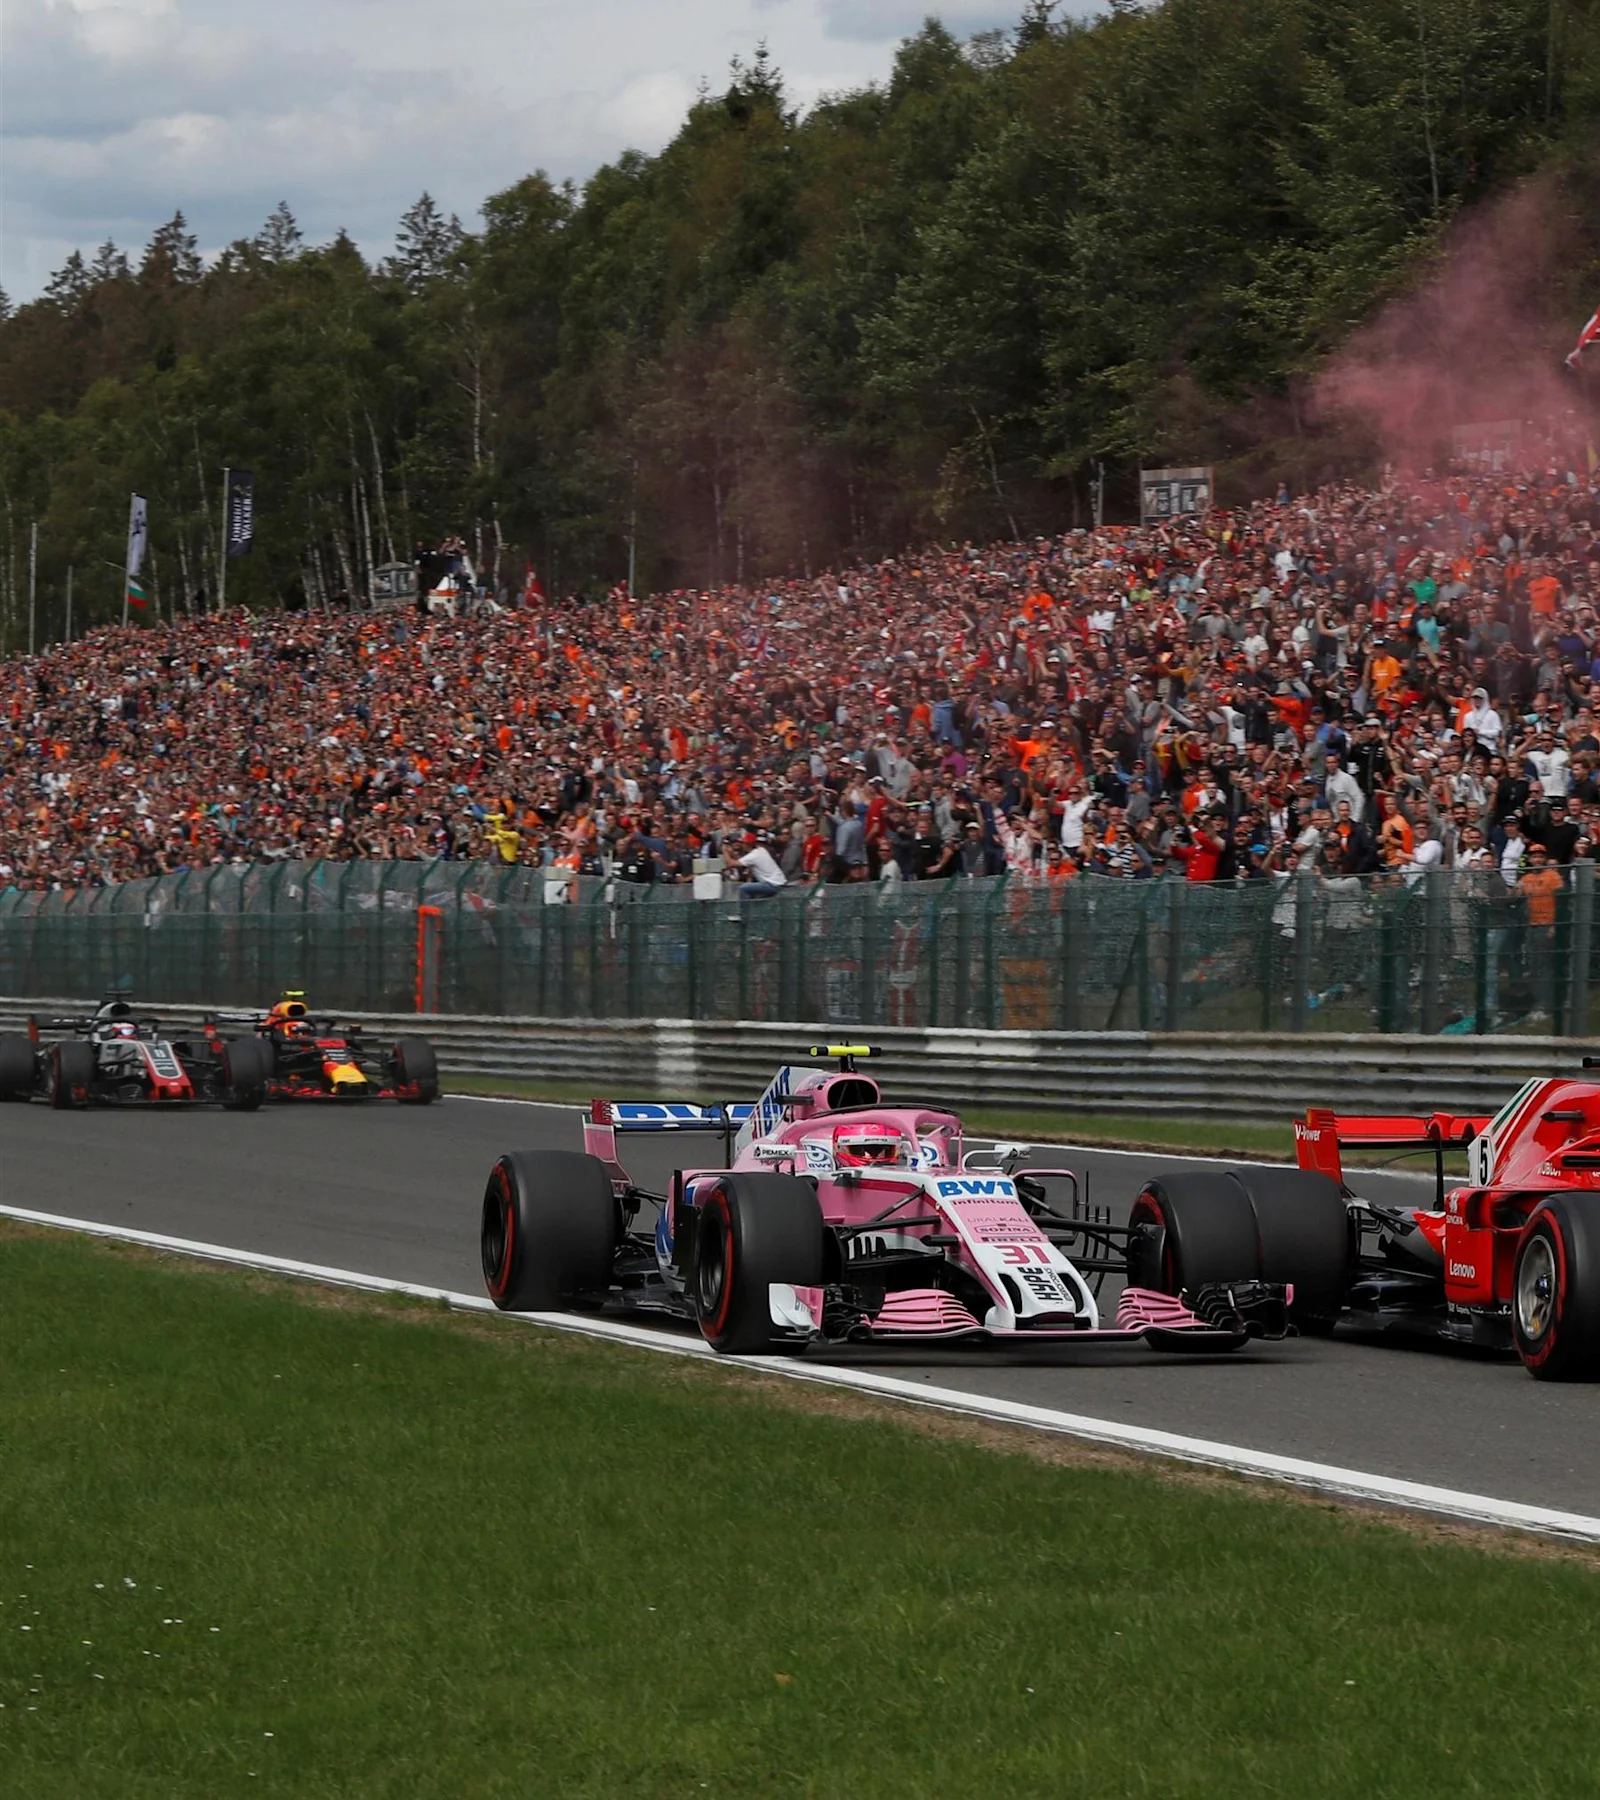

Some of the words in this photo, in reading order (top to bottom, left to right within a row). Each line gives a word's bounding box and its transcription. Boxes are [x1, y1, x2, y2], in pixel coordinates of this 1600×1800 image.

[1480, 1138, 1488, 1186] 5
[937, 1181, 1014, 1197] BWT
[994, 1245, 1051, 1264] 31
[1449, 1259, 1476, 1279] Lenovo
[1017, 1266, 1064, 1302] HYPE
